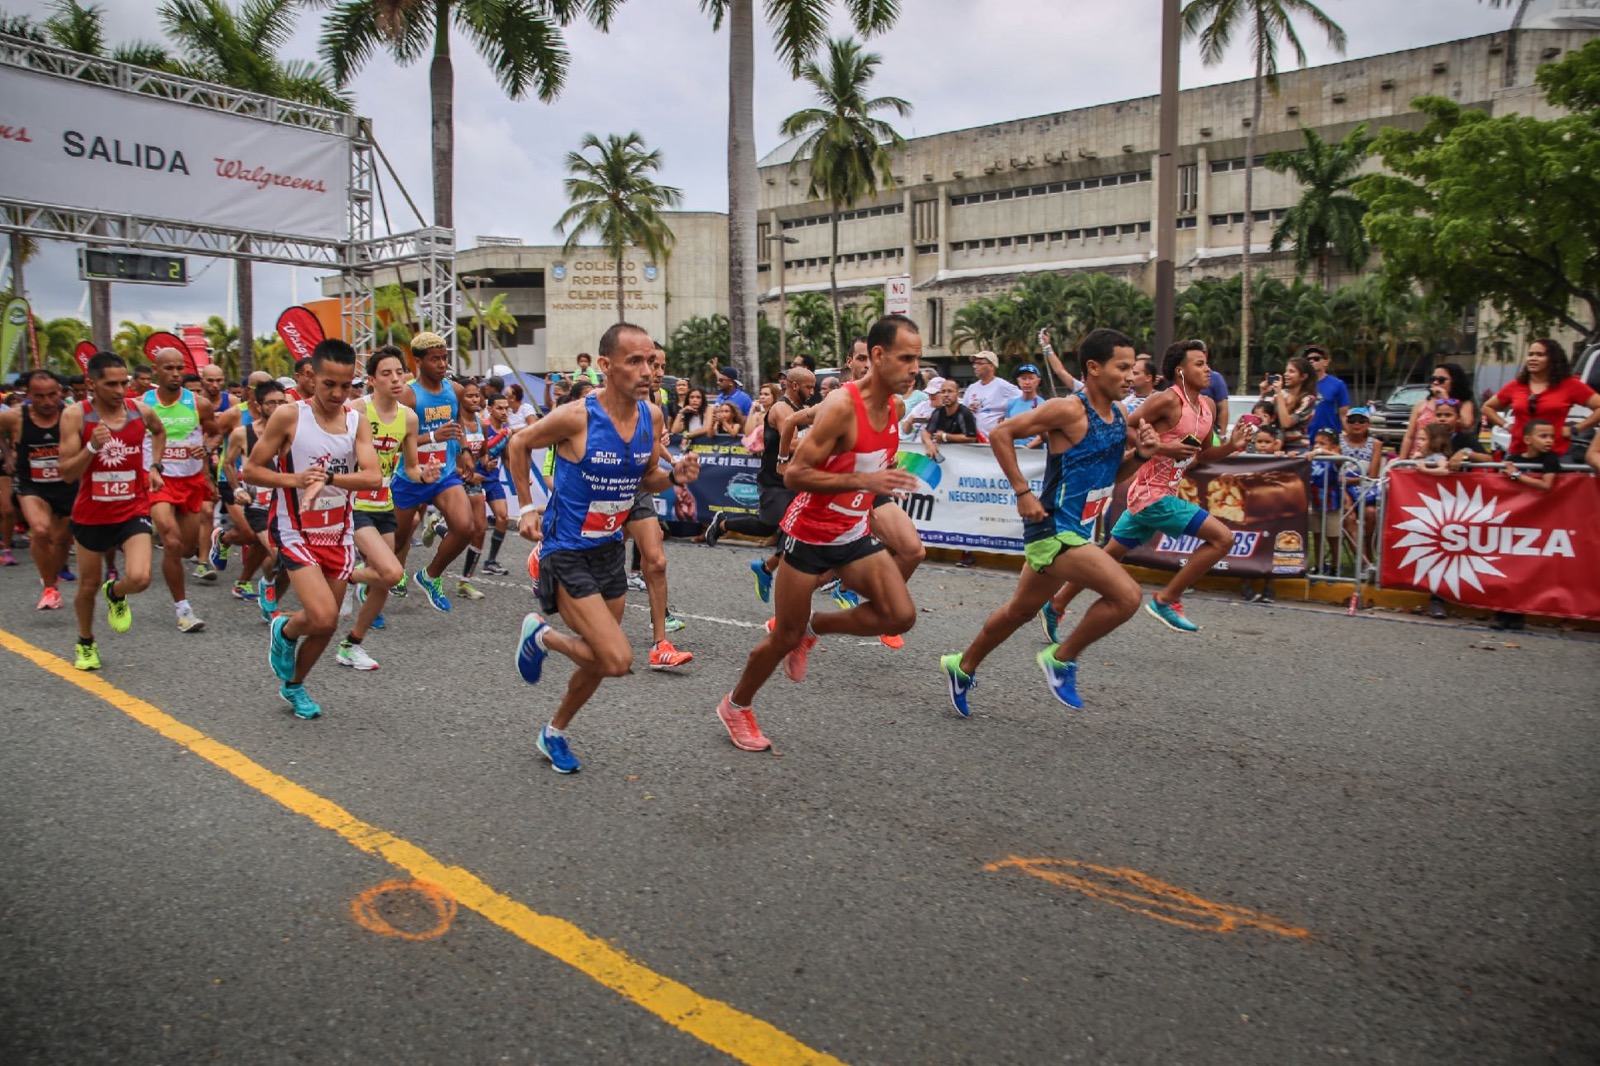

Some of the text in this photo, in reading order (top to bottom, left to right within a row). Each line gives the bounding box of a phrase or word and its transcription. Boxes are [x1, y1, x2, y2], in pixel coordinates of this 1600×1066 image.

[62, 130, 190, 176] SALIDA
[213, 157, 327, 193] Walgreens
[892, 283, 906, 295] NO
[110, 445, 141, 456] SUIZA
[163, 448, 187, 458] 948
[595, 450, 617, 458] ELITE
[591, 457, 622, 465] SPORT
[730, 457, 747, 468] DEL
[581, 470, 600, 483] Todo
[958, 476, 987, 489] AYUDA
[989, 478, 998, 490] A
[102, 482, 130, 495] 142
[851, 493, 864, 508] 8
[948, 490, 1009, 505] NECESIDADES
[321, 511, 330, 525] 1
[604, 515, 617, 530] 3
[1440, 523, 1576, 558] SUIZA
